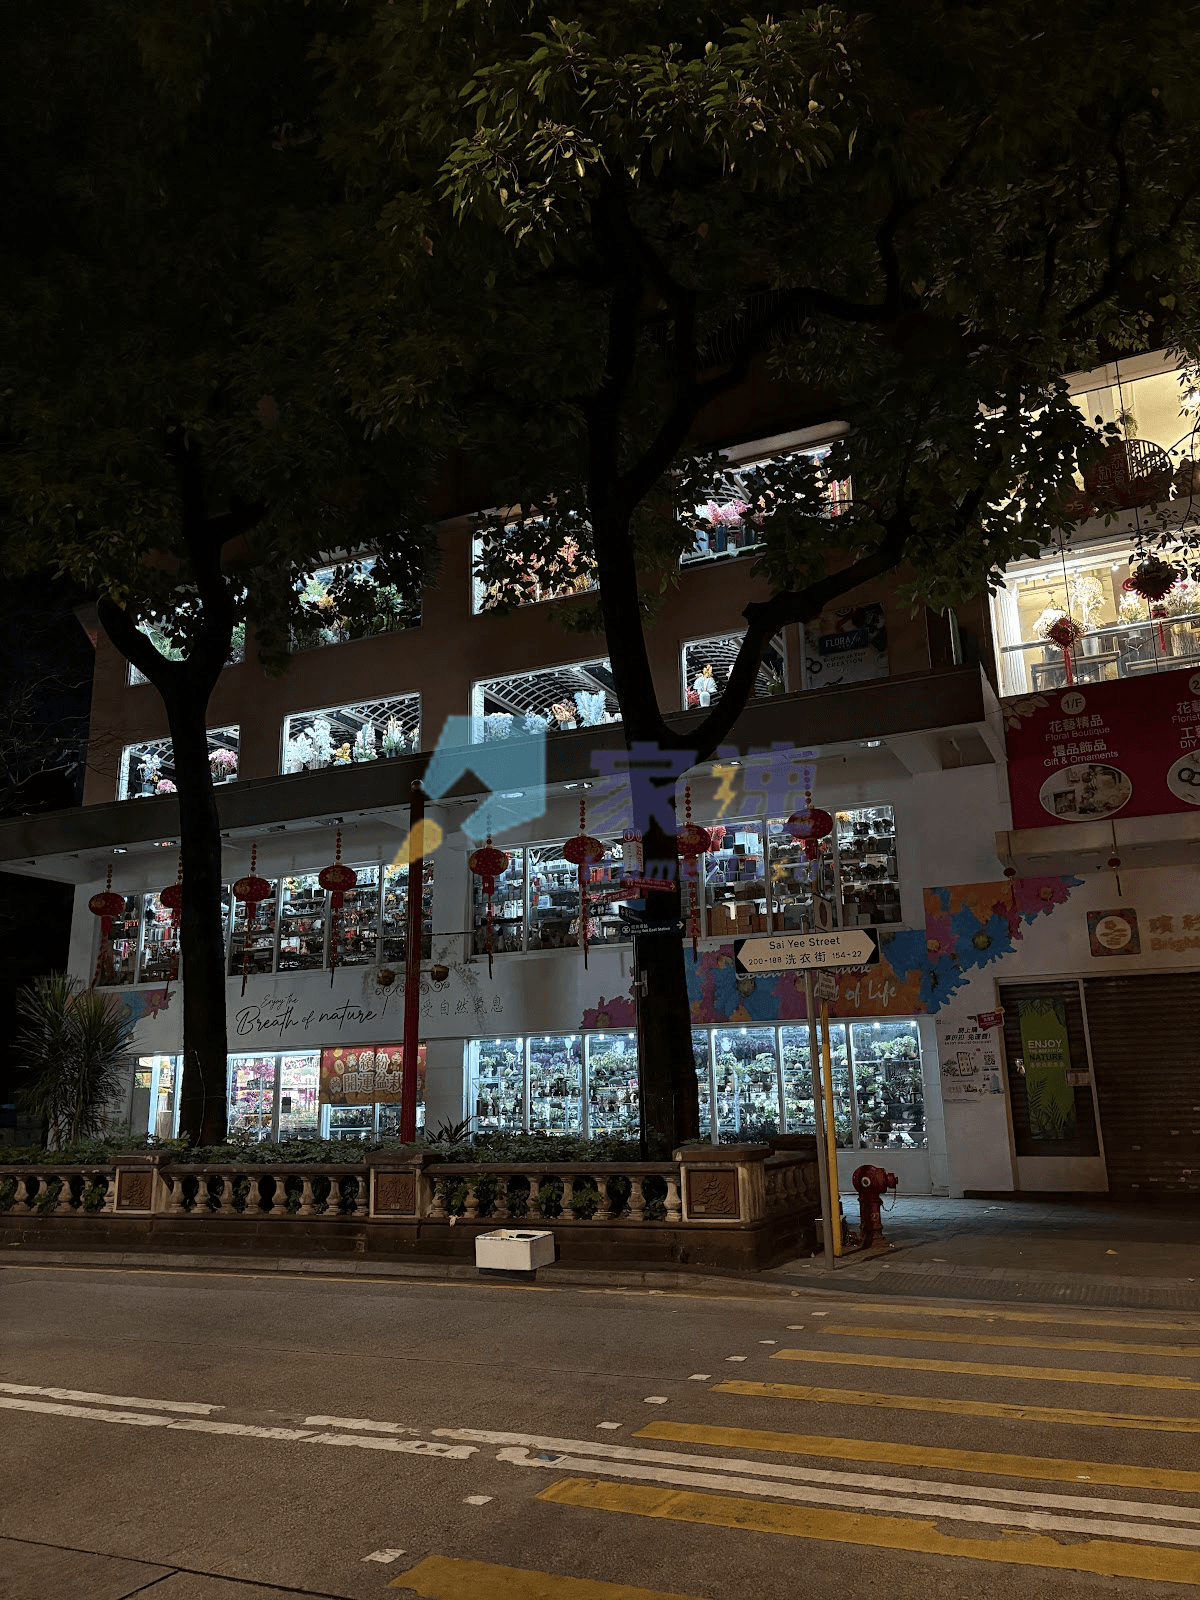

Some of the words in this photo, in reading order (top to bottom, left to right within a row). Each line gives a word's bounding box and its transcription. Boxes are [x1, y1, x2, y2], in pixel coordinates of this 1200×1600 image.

[1063, 697, 1083, 710] 1/F
[1049, 714, 1104, 733] 花藝精品
[1045, 732, 1070, 742] Floral
[1071, 726, 1110, 740] Boutique
[1052, 739, 1107, 757] 禮品飾品
[1180, 739, 1198, 749] DIY
[1043, 756, 1059, 767] Gift
[1061, 756, 1068, 765] &
[1069, 750, 1119, 765] Ornaments
[769, 940, 785, 950] Sai
[787, 938, 805, 948] Yee
[810, 936, 841, 947] Street
[785, 951, 827, 965] 洗衣街
[832, 950, 862, 959] 154-22
[260, 994, 285, 1010] Enjoy
[286, 992, 299, 1006] the
[845, 981, 862, 1008] of
[868, 979, 898, 1008] Life
[235, 1005, 299, 1037] Breath
[301, 1010, 316, 1030] of
[1028, 1039, 1062, 1048] ENJOY
[358, 1051, 391, 1072] 繽紛
[1029, 1053, 1064, 1061] NATURE
[342, 1070, 404, 1094] 開運盆栽
